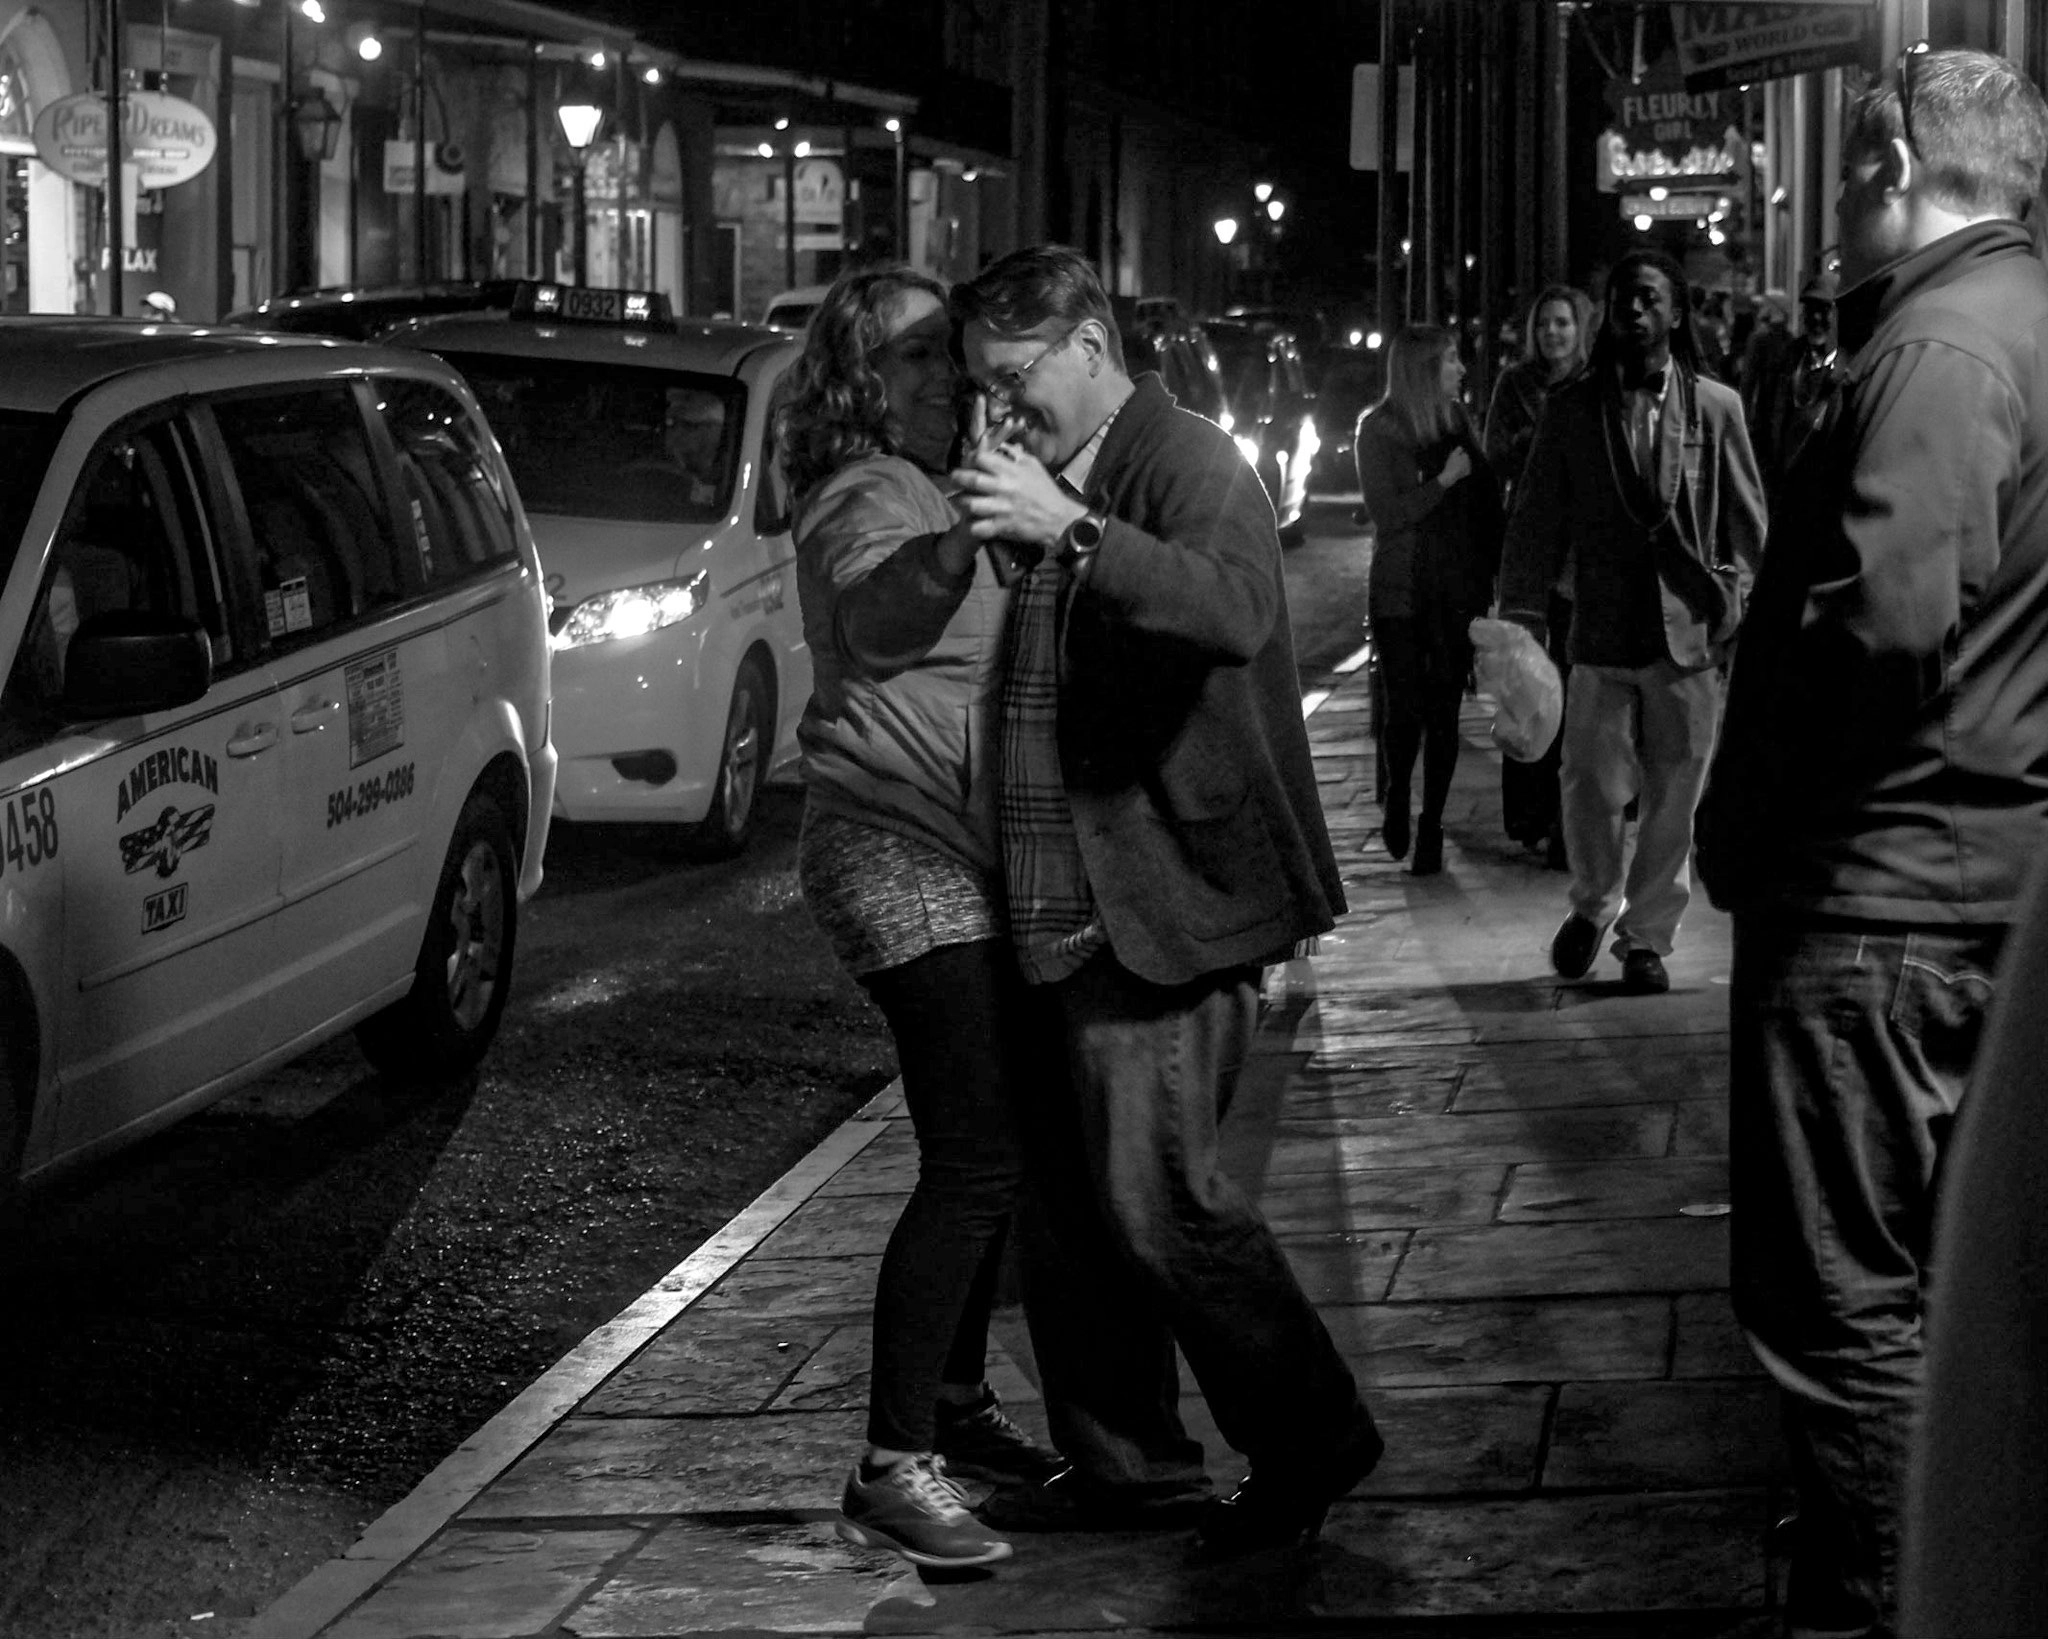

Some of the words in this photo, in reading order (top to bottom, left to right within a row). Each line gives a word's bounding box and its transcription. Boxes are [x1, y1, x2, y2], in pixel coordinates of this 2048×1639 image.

[117, 746, 219, 825] AMERICAN
[0, 787, 59, 879] 458
[145, 886, 186, 928] TAXI
